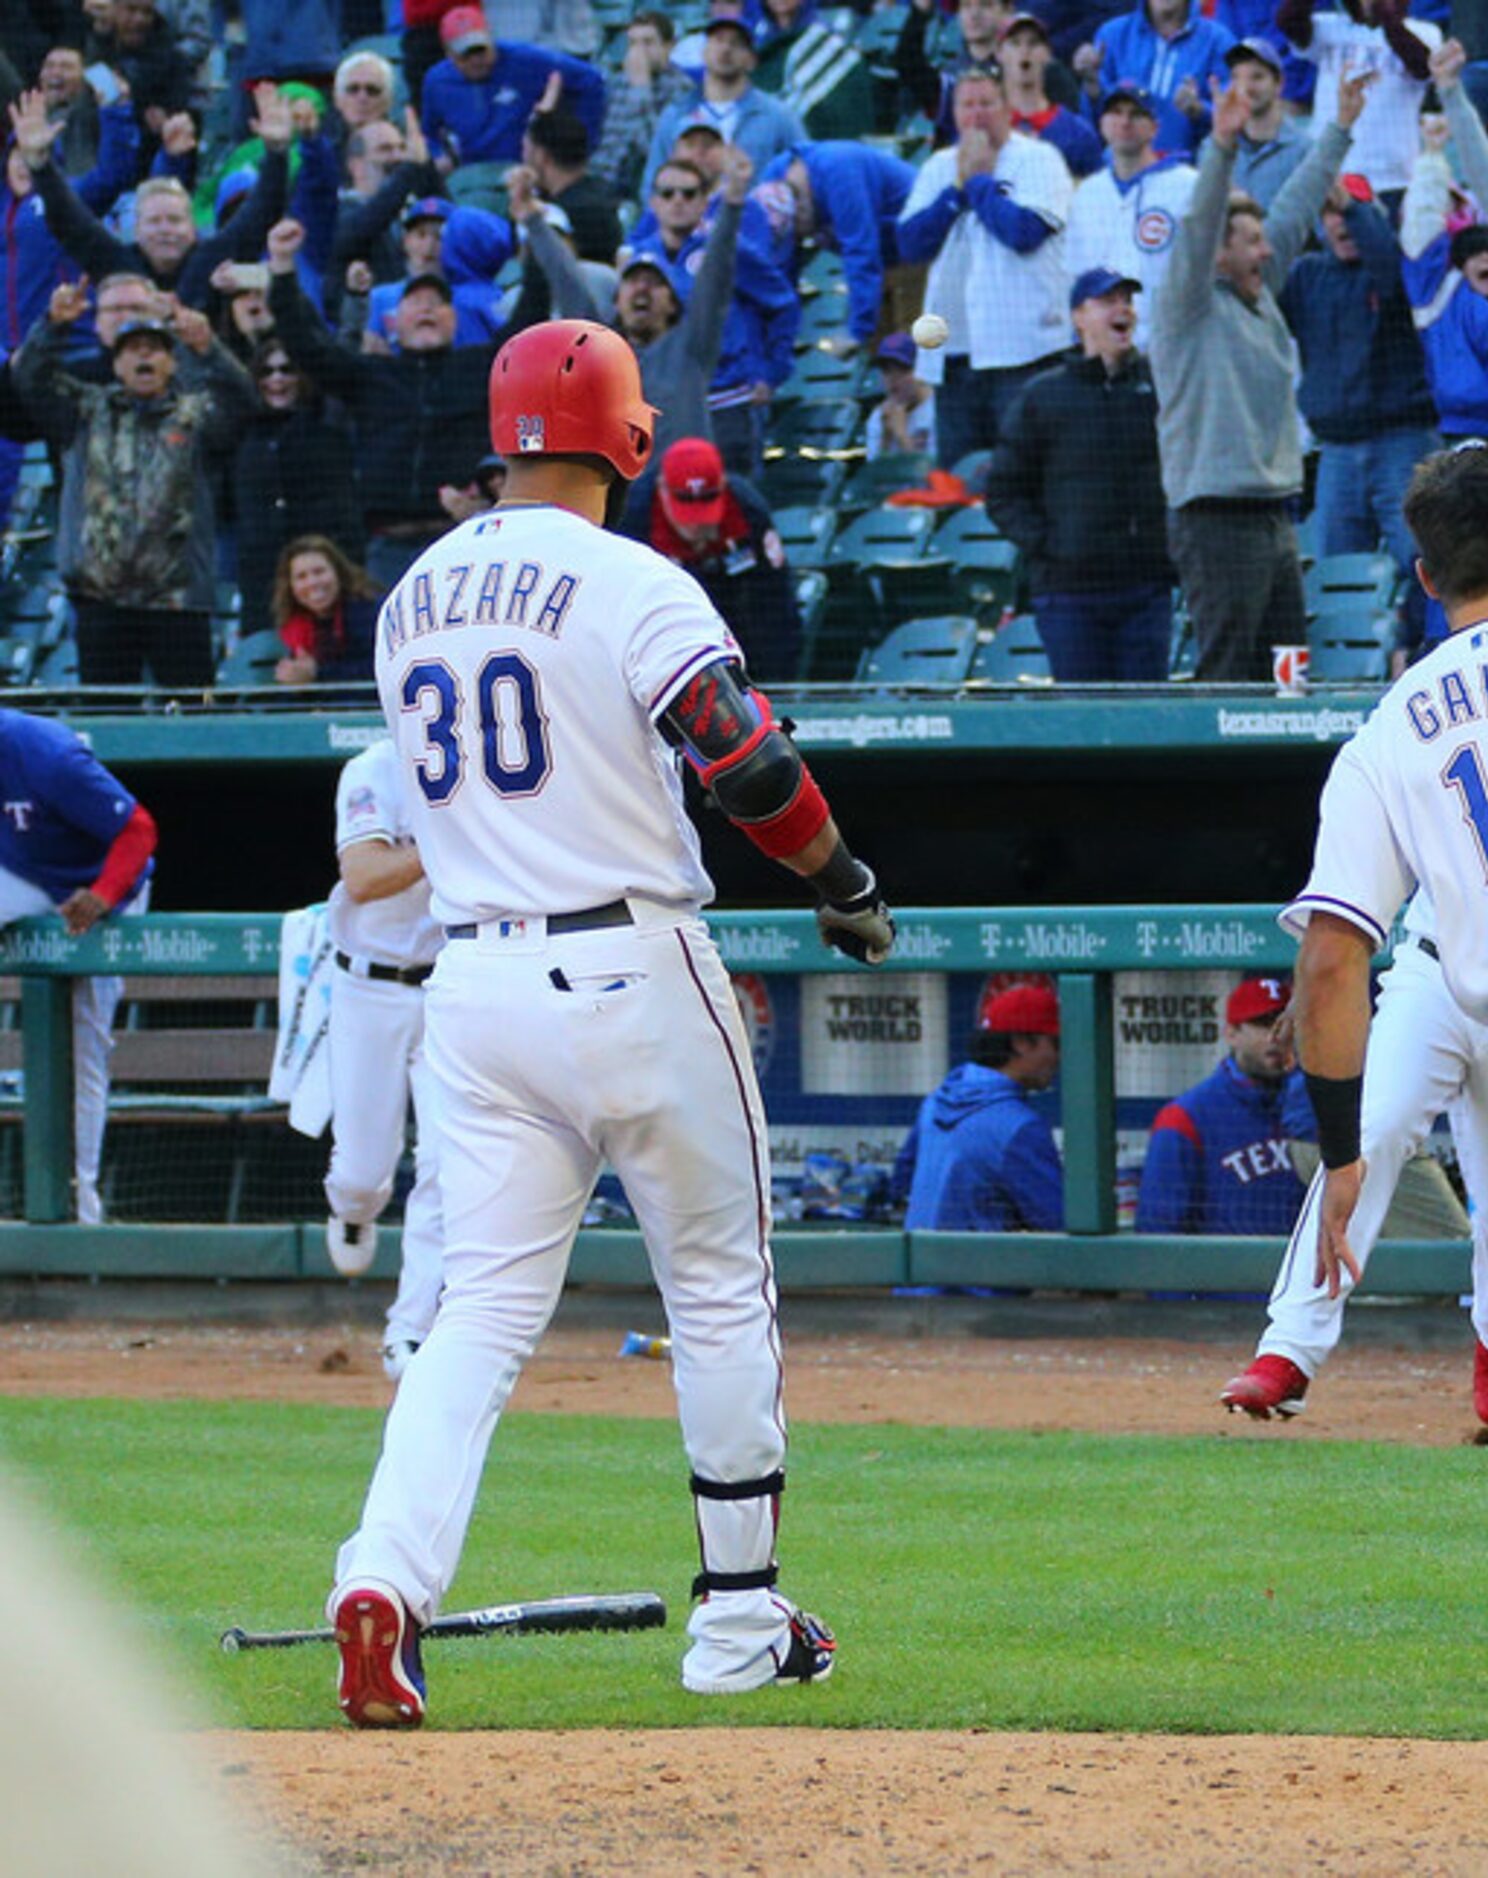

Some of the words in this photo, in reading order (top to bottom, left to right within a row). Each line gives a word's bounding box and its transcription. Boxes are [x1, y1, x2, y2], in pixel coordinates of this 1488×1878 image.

[516, 415, 545, 436] 30
[383, 559, 582, 660] MAZARA
[400, 648, 555, 808] 30
[3, 801, 33, 830] T
[1259, 978, 1282, 1000] T
[827, 995, 921, 1019] TRUCK
[1120, 996, 1218, 1019] TRUCK
[826, 1020, 923, 1042] WORLD
[1120, 1022, 1220, 1044] WORLD
